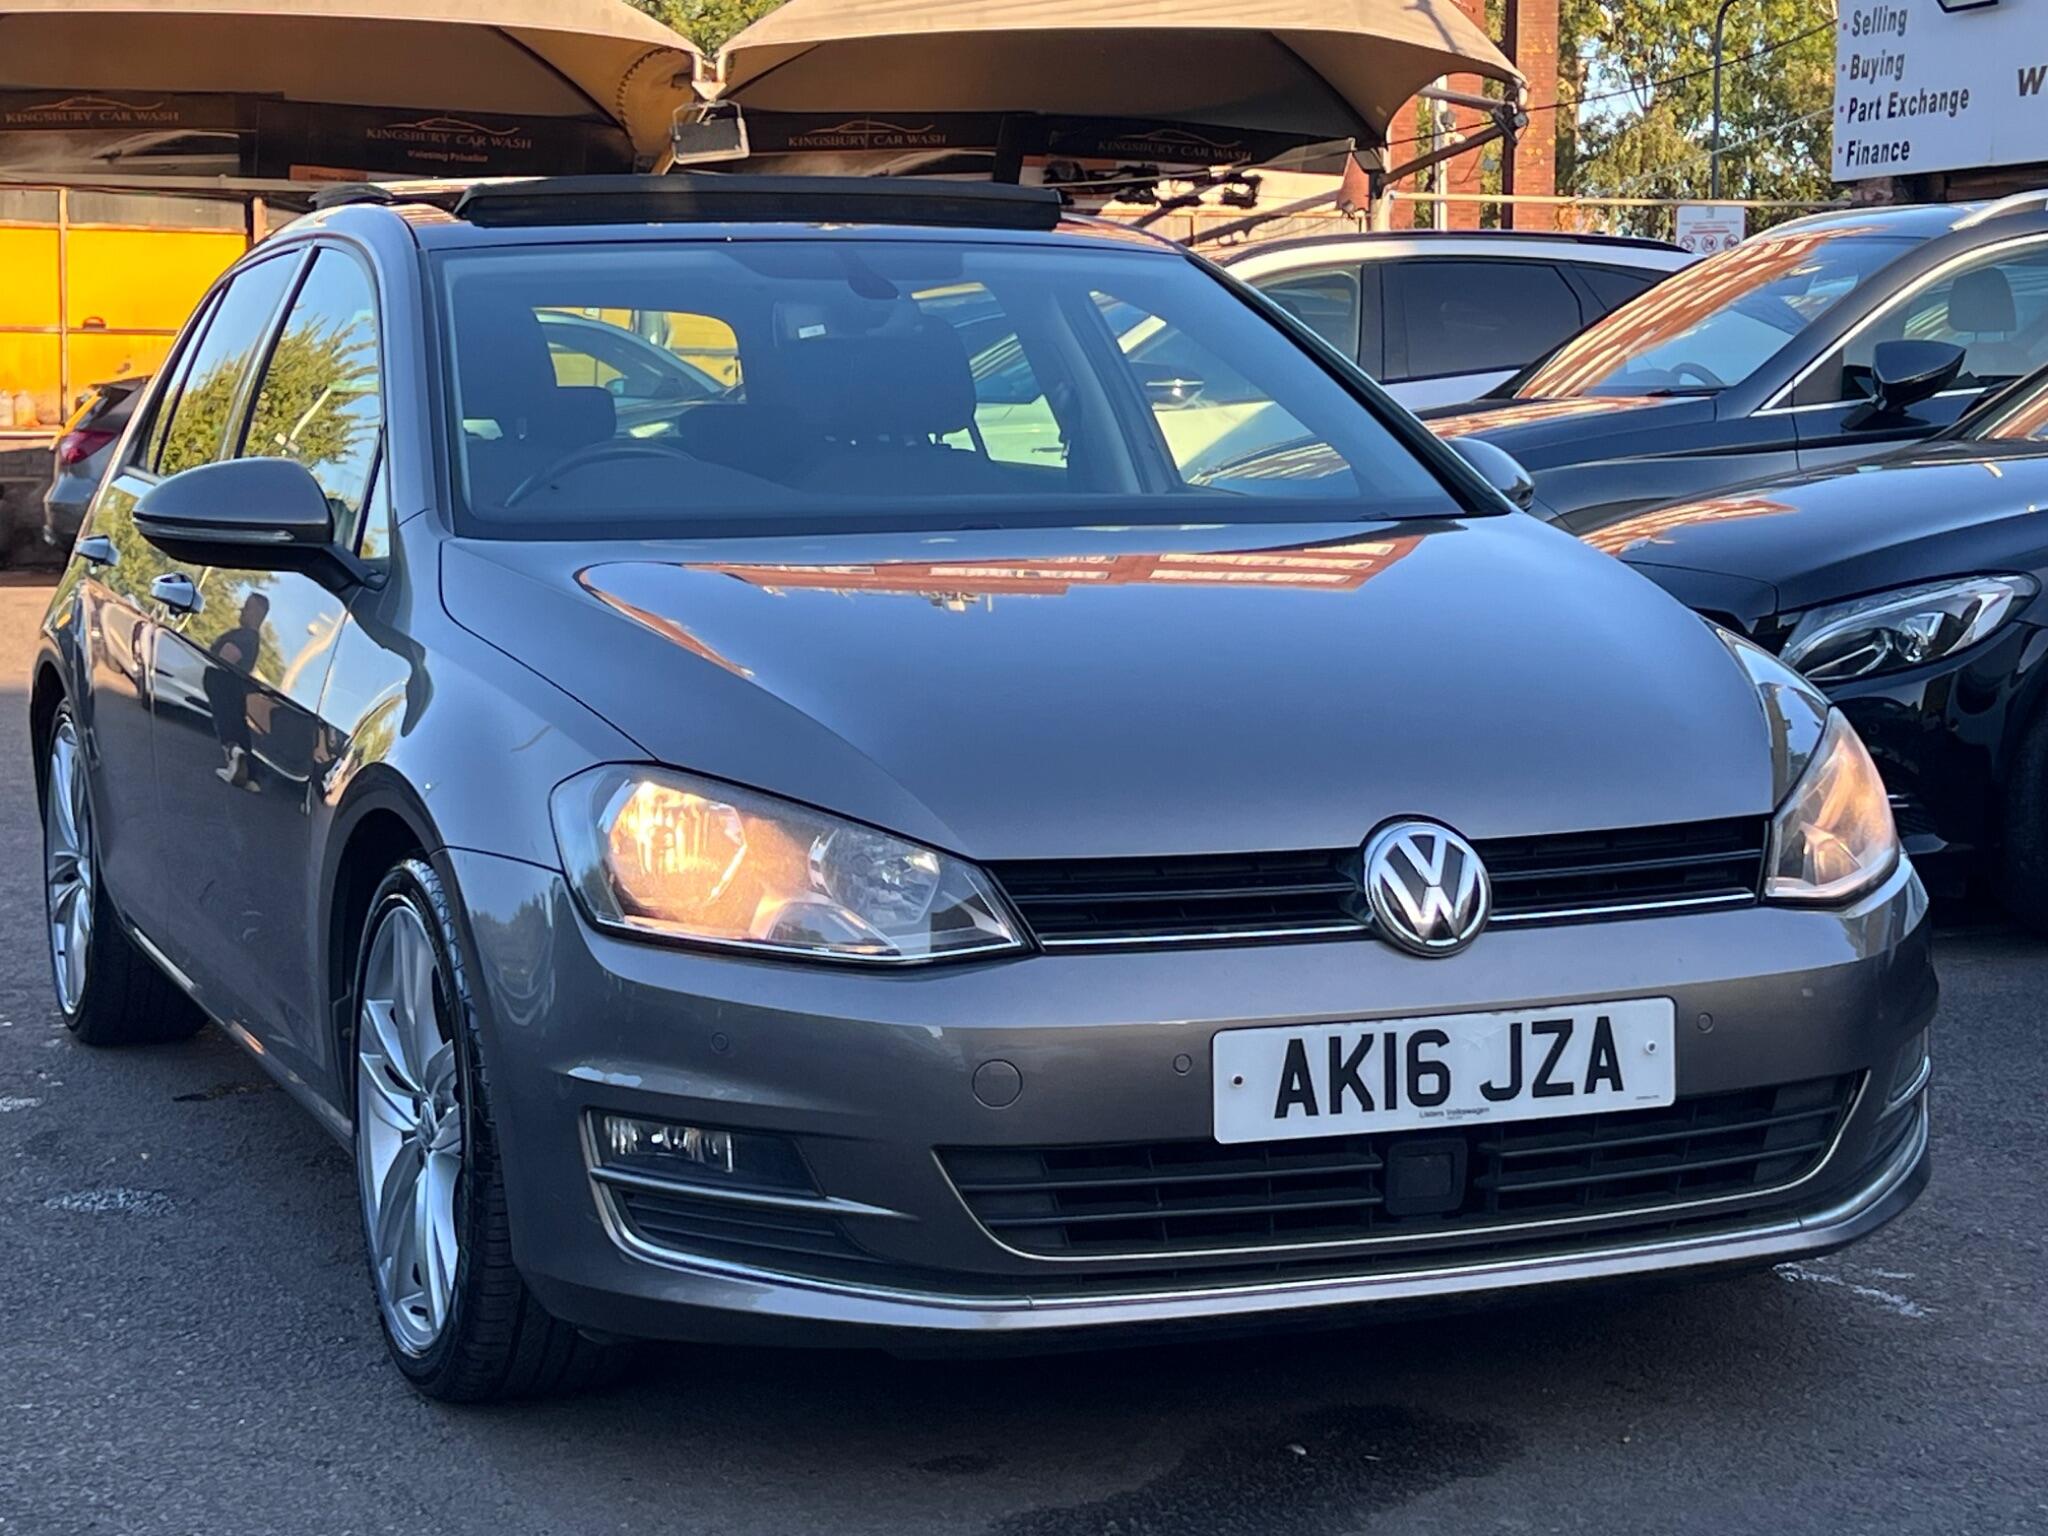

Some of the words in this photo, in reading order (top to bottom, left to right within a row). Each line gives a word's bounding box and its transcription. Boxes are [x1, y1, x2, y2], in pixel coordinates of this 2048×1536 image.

[1851, 5, 1908, 37] Selling
[1849, 49, 1905, 84] Buying
[5, 110, 92, 124] KINGSBURY
[99, 111, 132, 121] CAR
[136, 111, 179, 121] WASH
[1847, 96, 1881, 124] Part
[1887, 87, 1970, 119] Exchange
[366, 127, 450, 144] KINGSBURY
[456, 134, 486, 148] CAR
[490, 137, 532, 150] WASH
[788, 135, 866, 147] KINGSBURY
[873, 134, 903, 146] CAR
[906, 134, 946, 145] WASH
[1180, 145, 1208, 158] CAR
[1846, 139, 1911, 168] Finance
[1274, 1028, 1451, 1119] AK16
[1479, 1015, 1625, 1103] JZA
